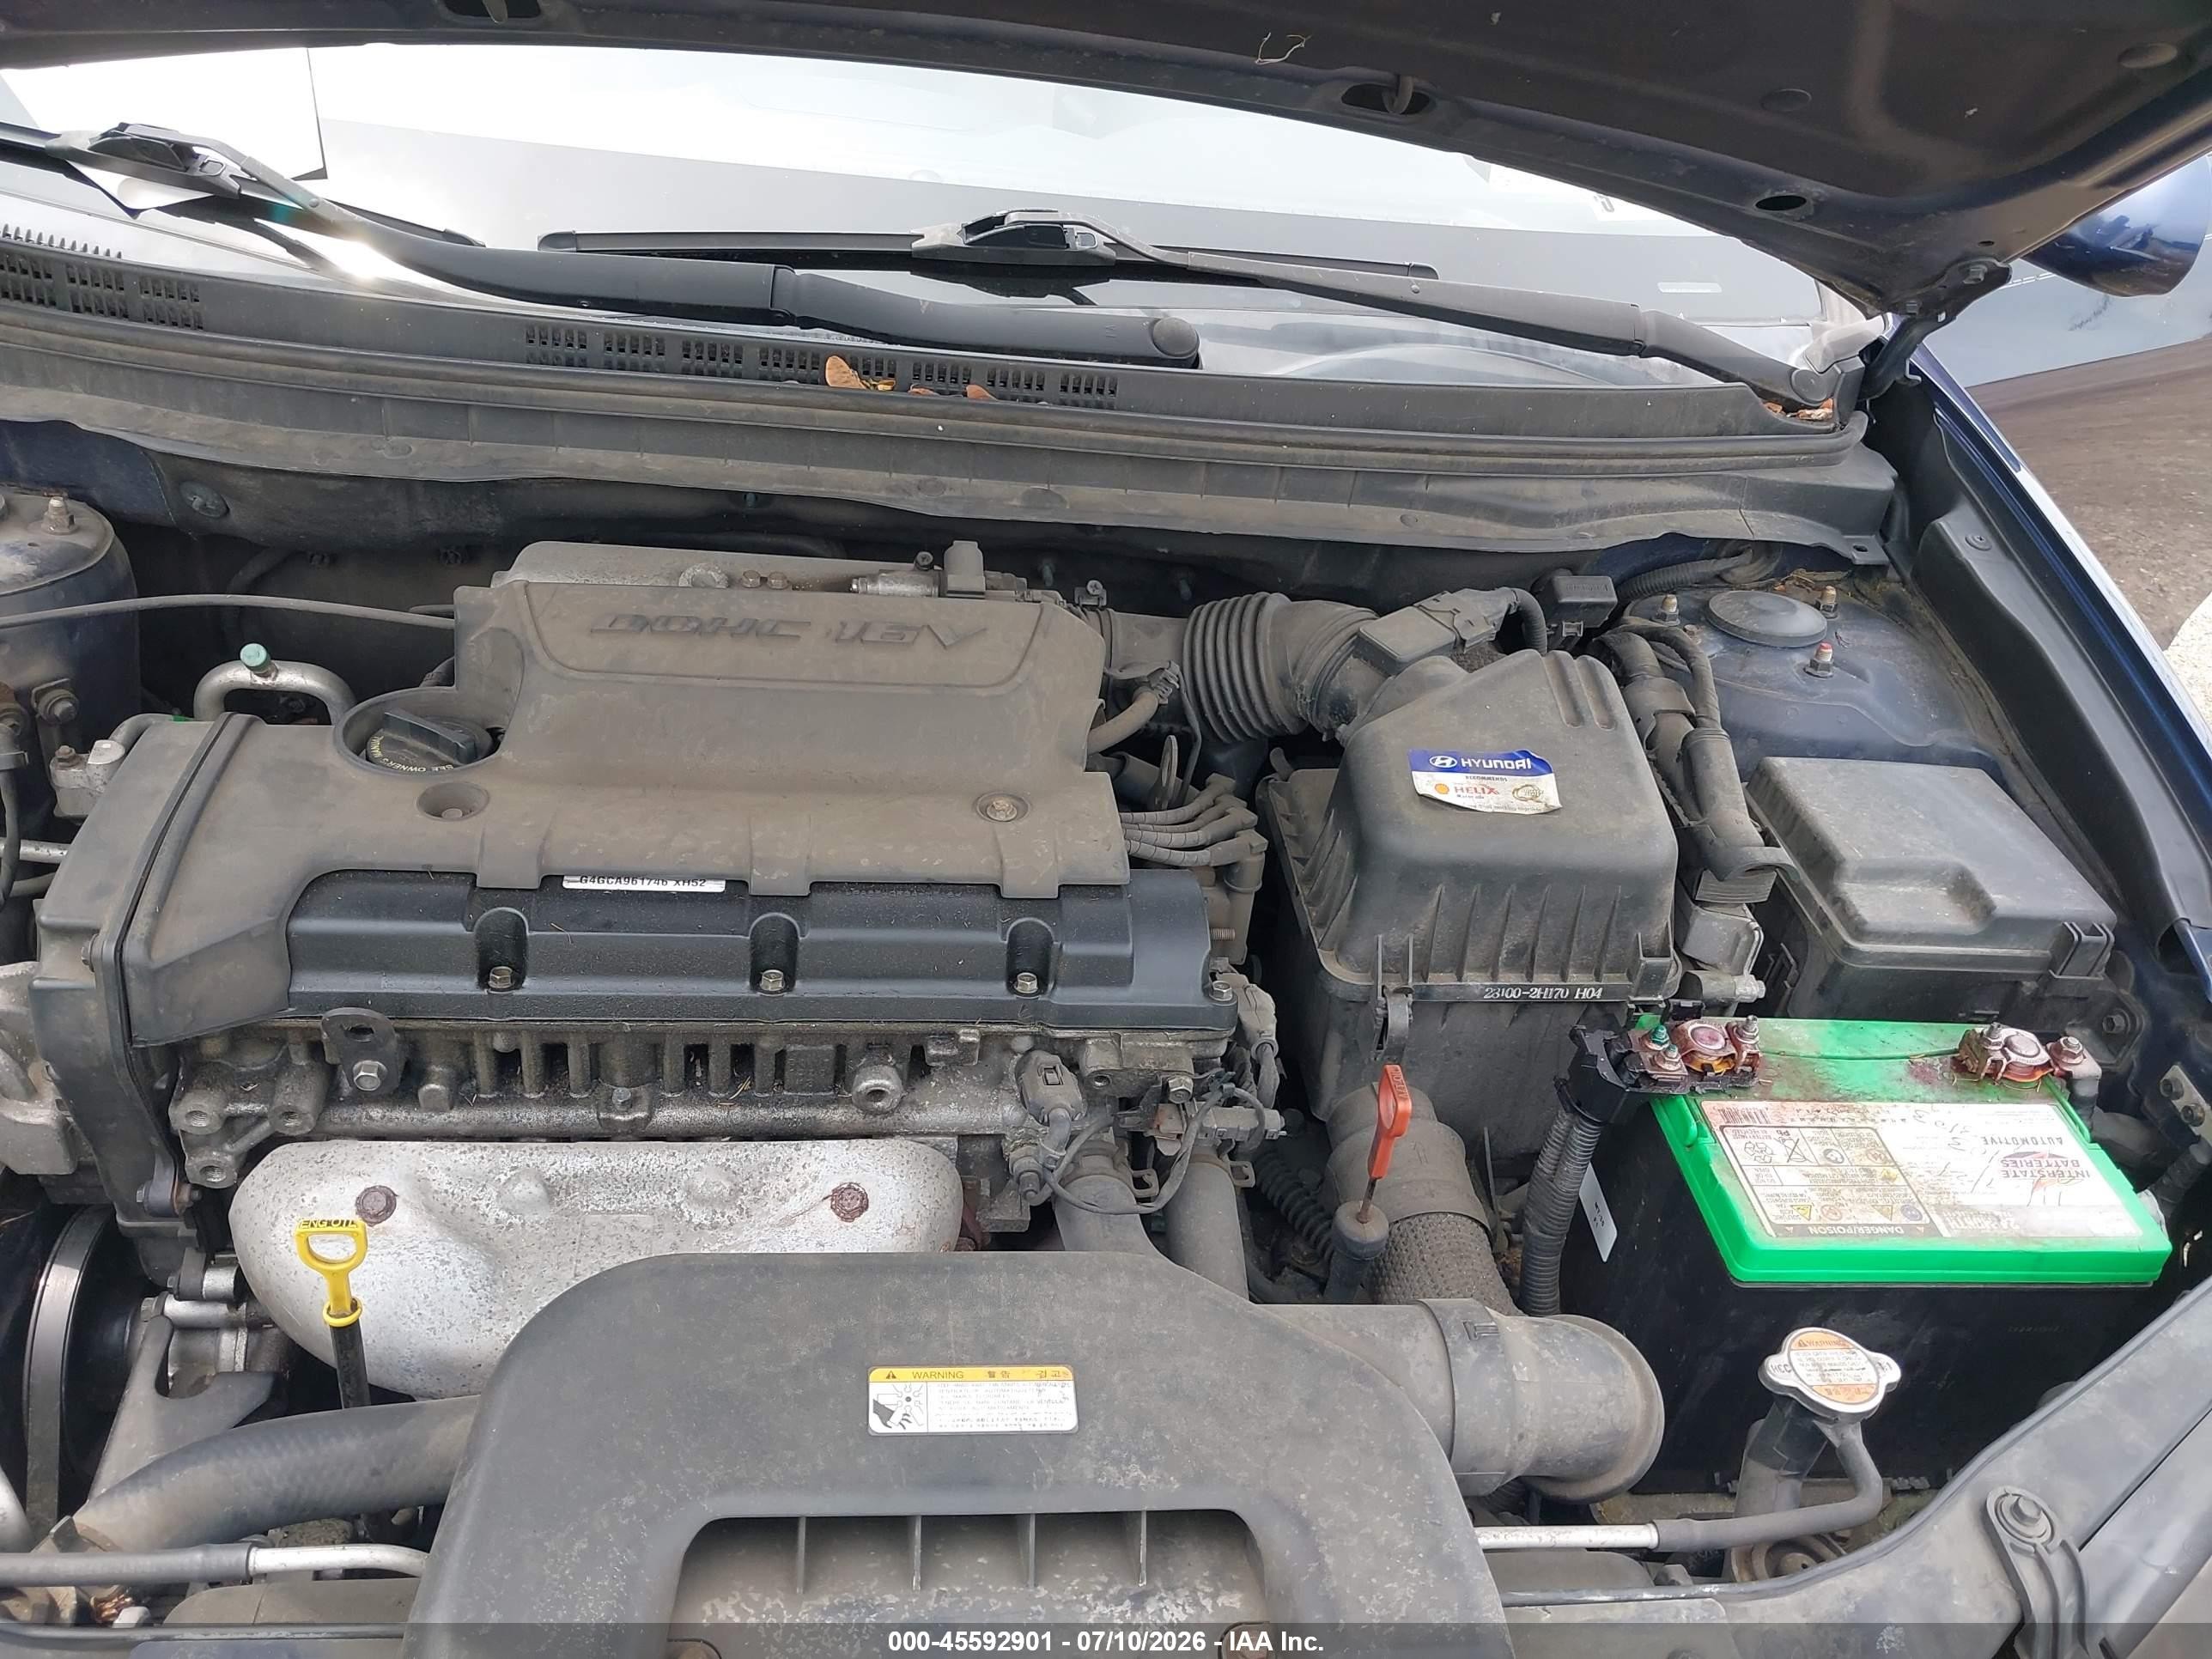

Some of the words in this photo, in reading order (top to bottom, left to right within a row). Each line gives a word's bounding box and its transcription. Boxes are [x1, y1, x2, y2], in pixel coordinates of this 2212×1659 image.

[590, 613, 811, 639] DOHC
[833, 619, 989, 649] 16V
[1461, 757, 1532, 770] HYUNDAI
[1454, 785, 1499, 795] HELIX
[1574, 987, 1603, 1000] H04
[1981, 1136, 2063, 1146] AUTOMOTIVE
[2001, 1159, 2081, 1168] BATTERIES
[2001, 1170, 2090, 1178] INTERSTATE
[1808, 1225, 1905, 1235] DANGER/POISON
[912, 1370, 964, 1379] WARNING
